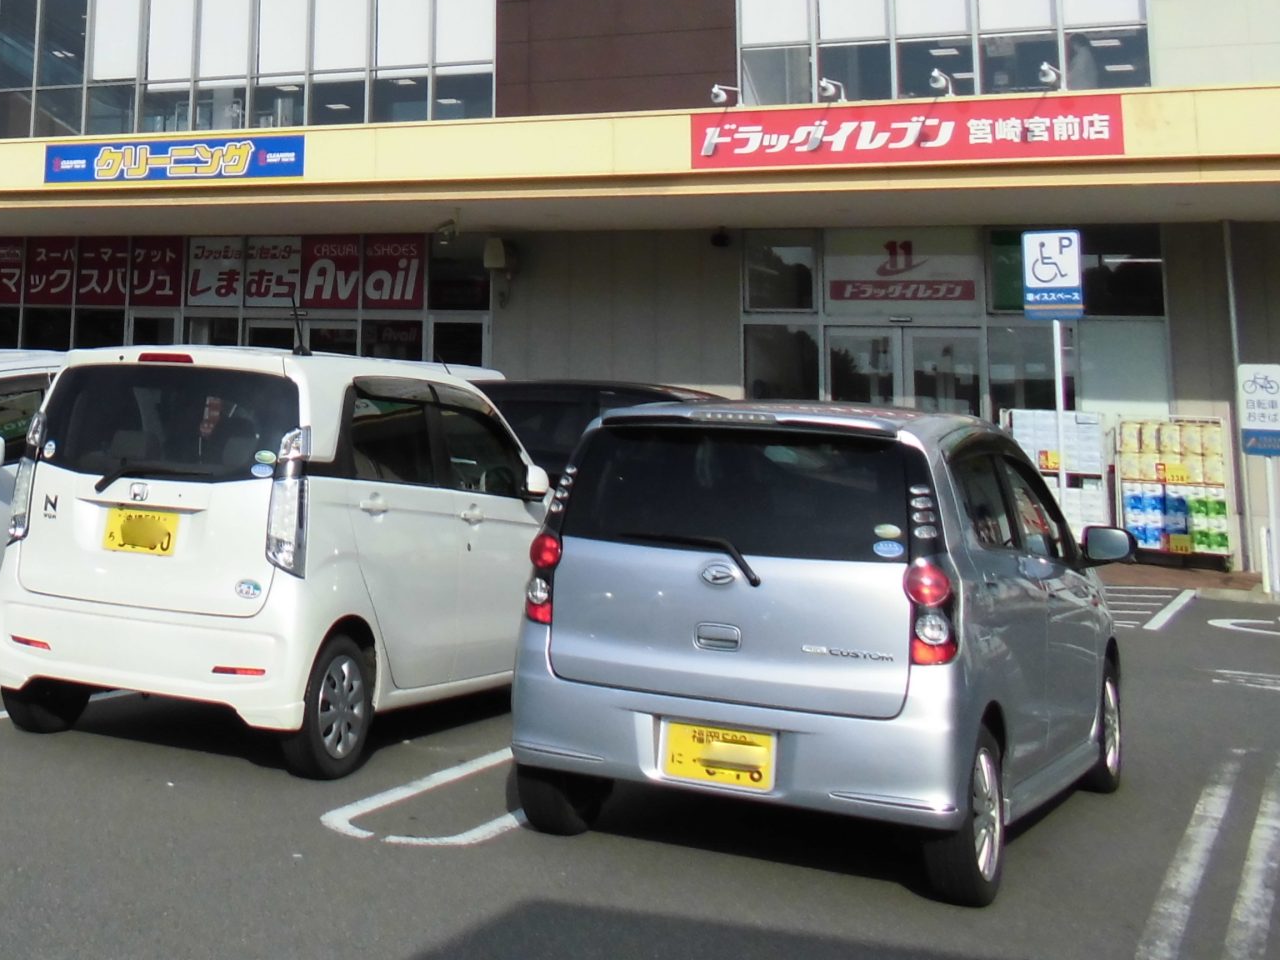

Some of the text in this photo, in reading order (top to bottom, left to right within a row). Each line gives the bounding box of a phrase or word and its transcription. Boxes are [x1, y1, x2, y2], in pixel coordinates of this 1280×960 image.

[700, 115, 955, 157] ドラッグイレブン
[94, 141, 254, 179] クリーニング
[1059, 236, 1073, 255] P
[0, 268, 174, 295] マックスバリュ
[189, 268, 300, 298] しまむら
[304, 258, 419, 301] Avail
[844, 283, 964, 299] ドラッグイレブン
[43, 494, 59, 512] N
[829, 647, 894, 662] CUSTOM
